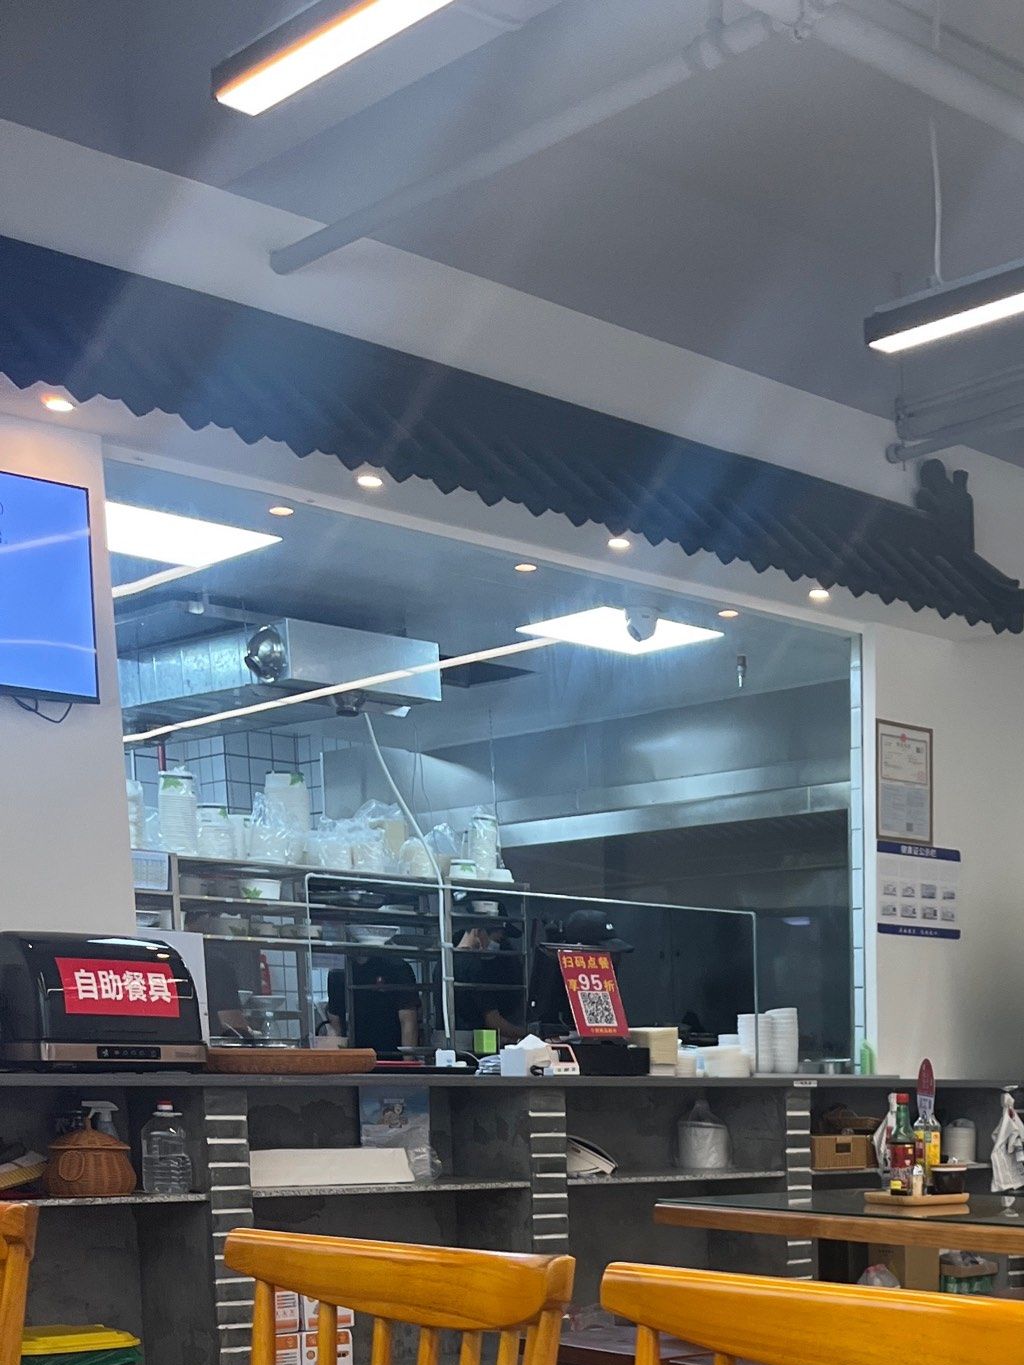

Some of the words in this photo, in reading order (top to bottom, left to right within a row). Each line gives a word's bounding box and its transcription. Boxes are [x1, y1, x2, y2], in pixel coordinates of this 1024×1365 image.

[562, 955, 609, 969] 扫码点餐
[74, 969, 171, 1003] 自助餐具
[568, 974, 614, 992] 享95折
